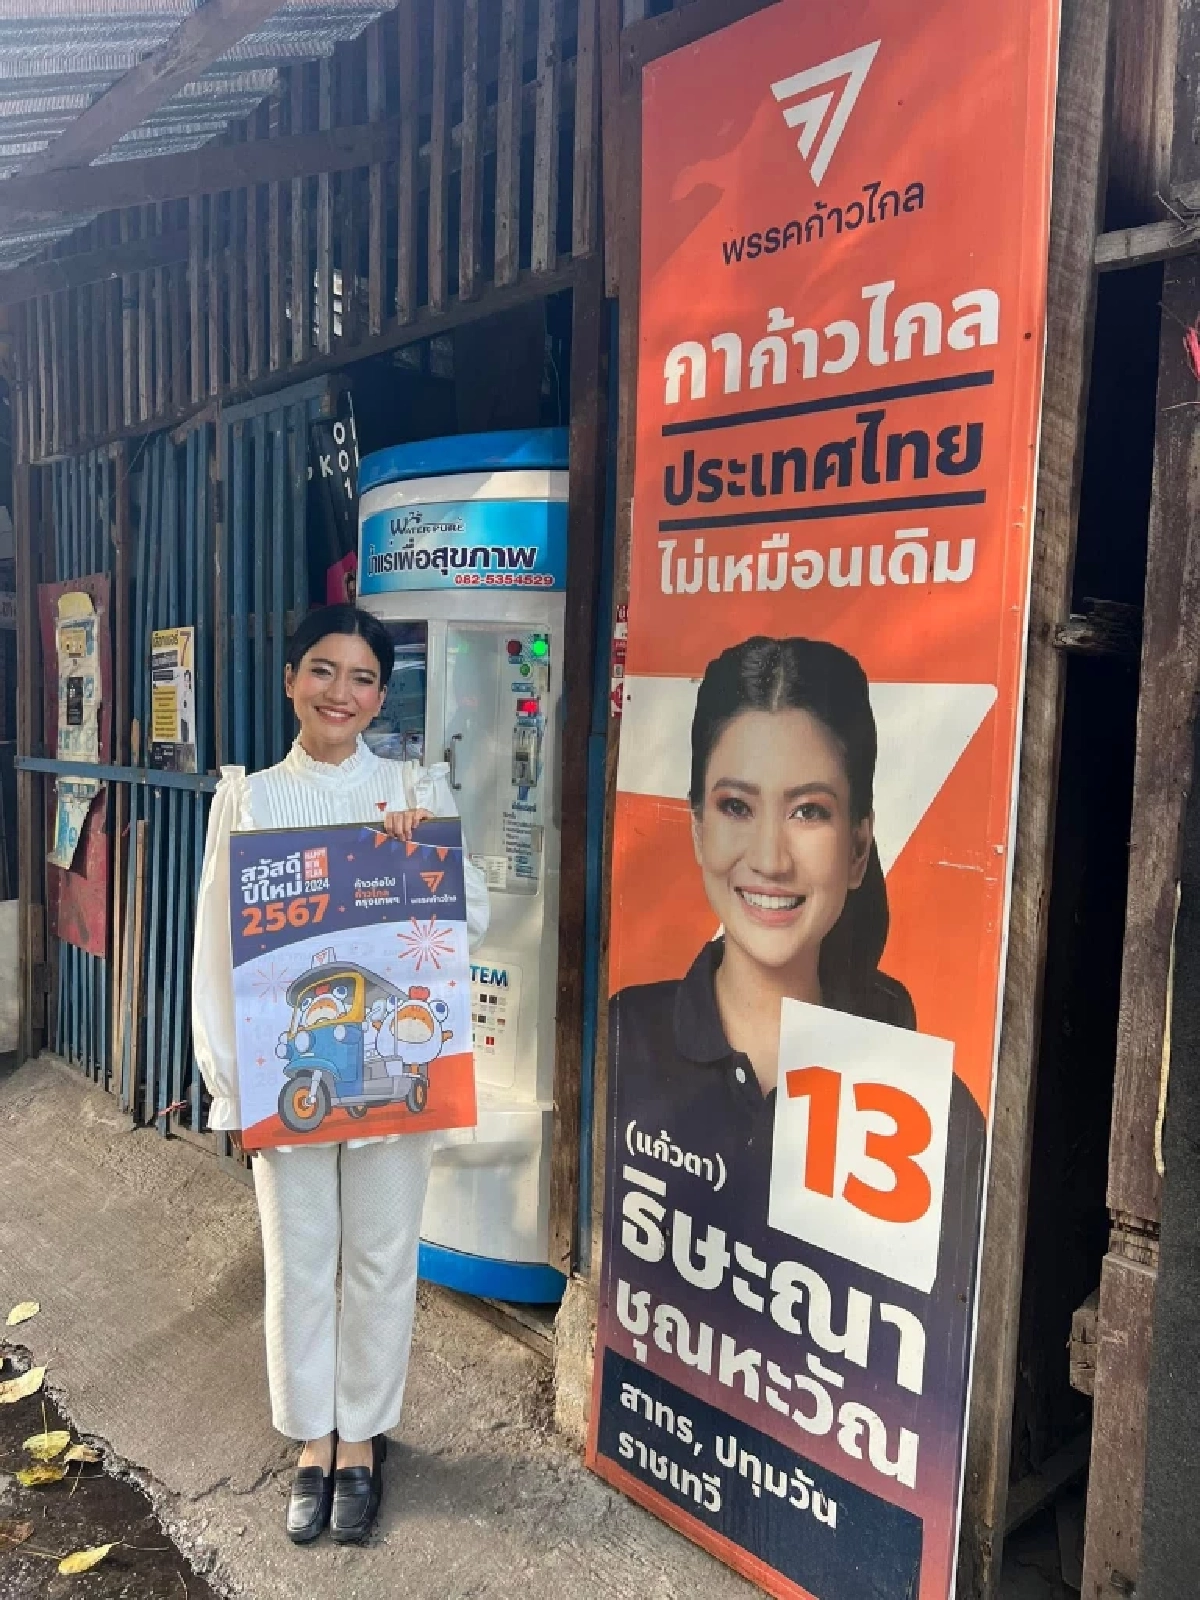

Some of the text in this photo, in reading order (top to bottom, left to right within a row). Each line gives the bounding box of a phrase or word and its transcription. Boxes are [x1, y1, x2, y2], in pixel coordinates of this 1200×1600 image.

[722, 181, 924, 266] พรรคก้าวไกล
[664, 280, 999, 405] กาก้าวไกล
[664, 409, 984, 506] ประเทศไทย
[658, 527, 975, 595] ไม่เหมือนเดิม
[241, 851, 301, 883] สวัสดี
[241, 873, 302, 905] ปีใหม่
[242, 894, 330, 937] 2567
[626, 1119, 727, 1192] (แก้วตา)
[786, 1066, 932, 1224] 13
[622, 1164, 927, 1395] ธิษะณา
[616, 1277, 919, 1490] ชุณหะวัณ
[618, 1430, 722, 1515] ราชเทวี
[621, 1380, 838, 1530] สาทร, ปทุมวัน
